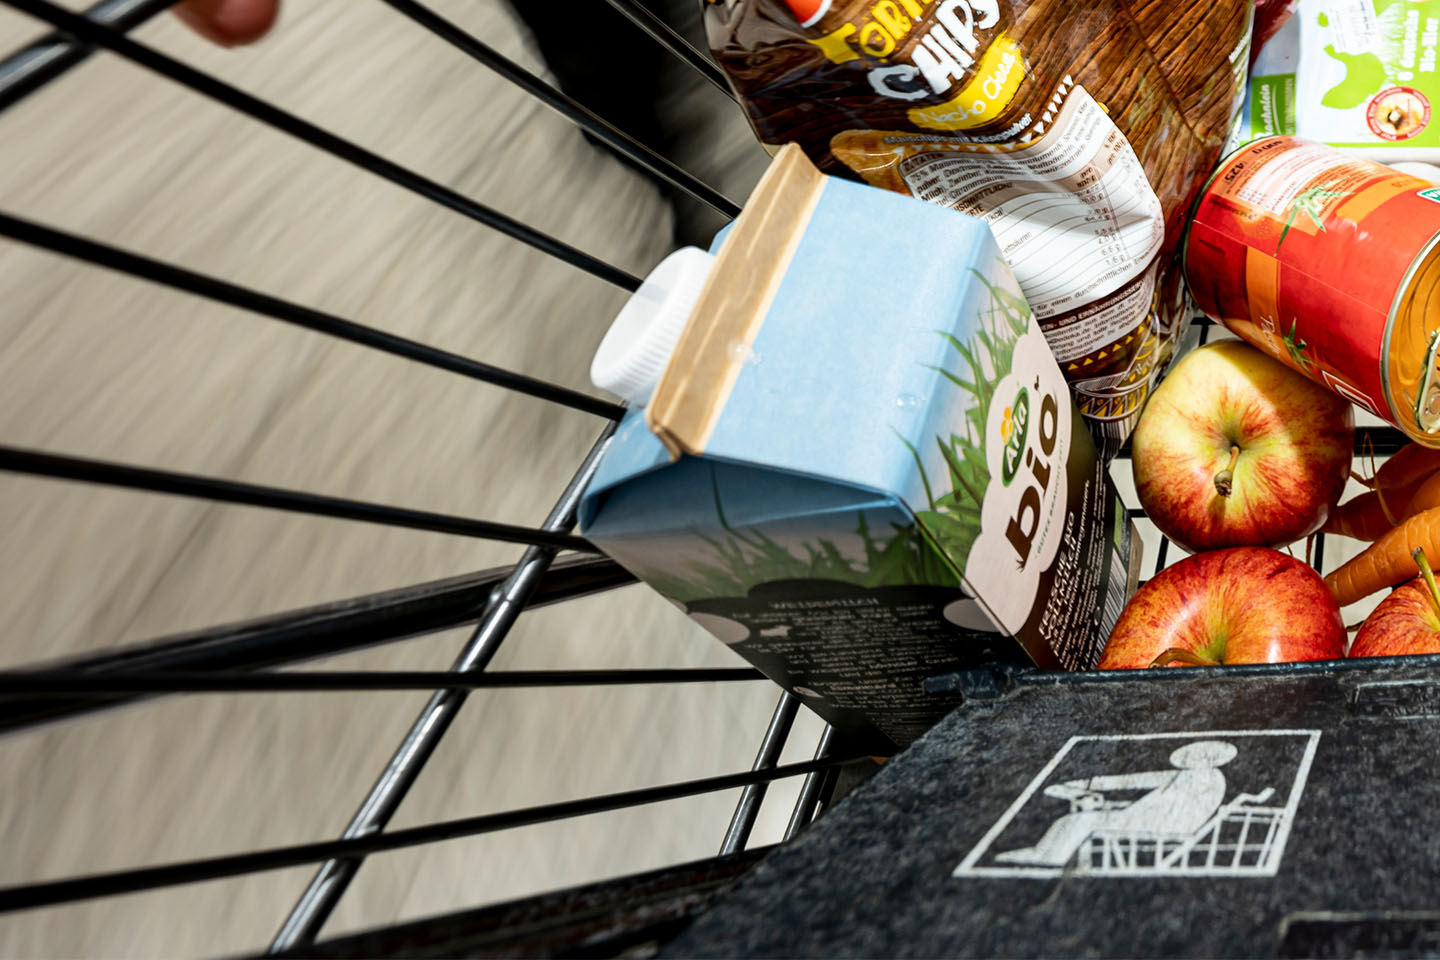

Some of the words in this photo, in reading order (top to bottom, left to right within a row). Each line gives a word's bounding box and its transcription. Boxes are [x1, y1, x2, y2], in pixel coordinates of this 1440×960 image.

[919, 100, 986, 123] Nacho
[1005, 393, 1058, 569] bio
[1006, 402, 1028, 474] Arla
[1039, 549, 1067, 638] FRISCHE
[1064, 511, 1075, 545] BIO
[1045, 537, 1076, 640] VOLLMILCH
